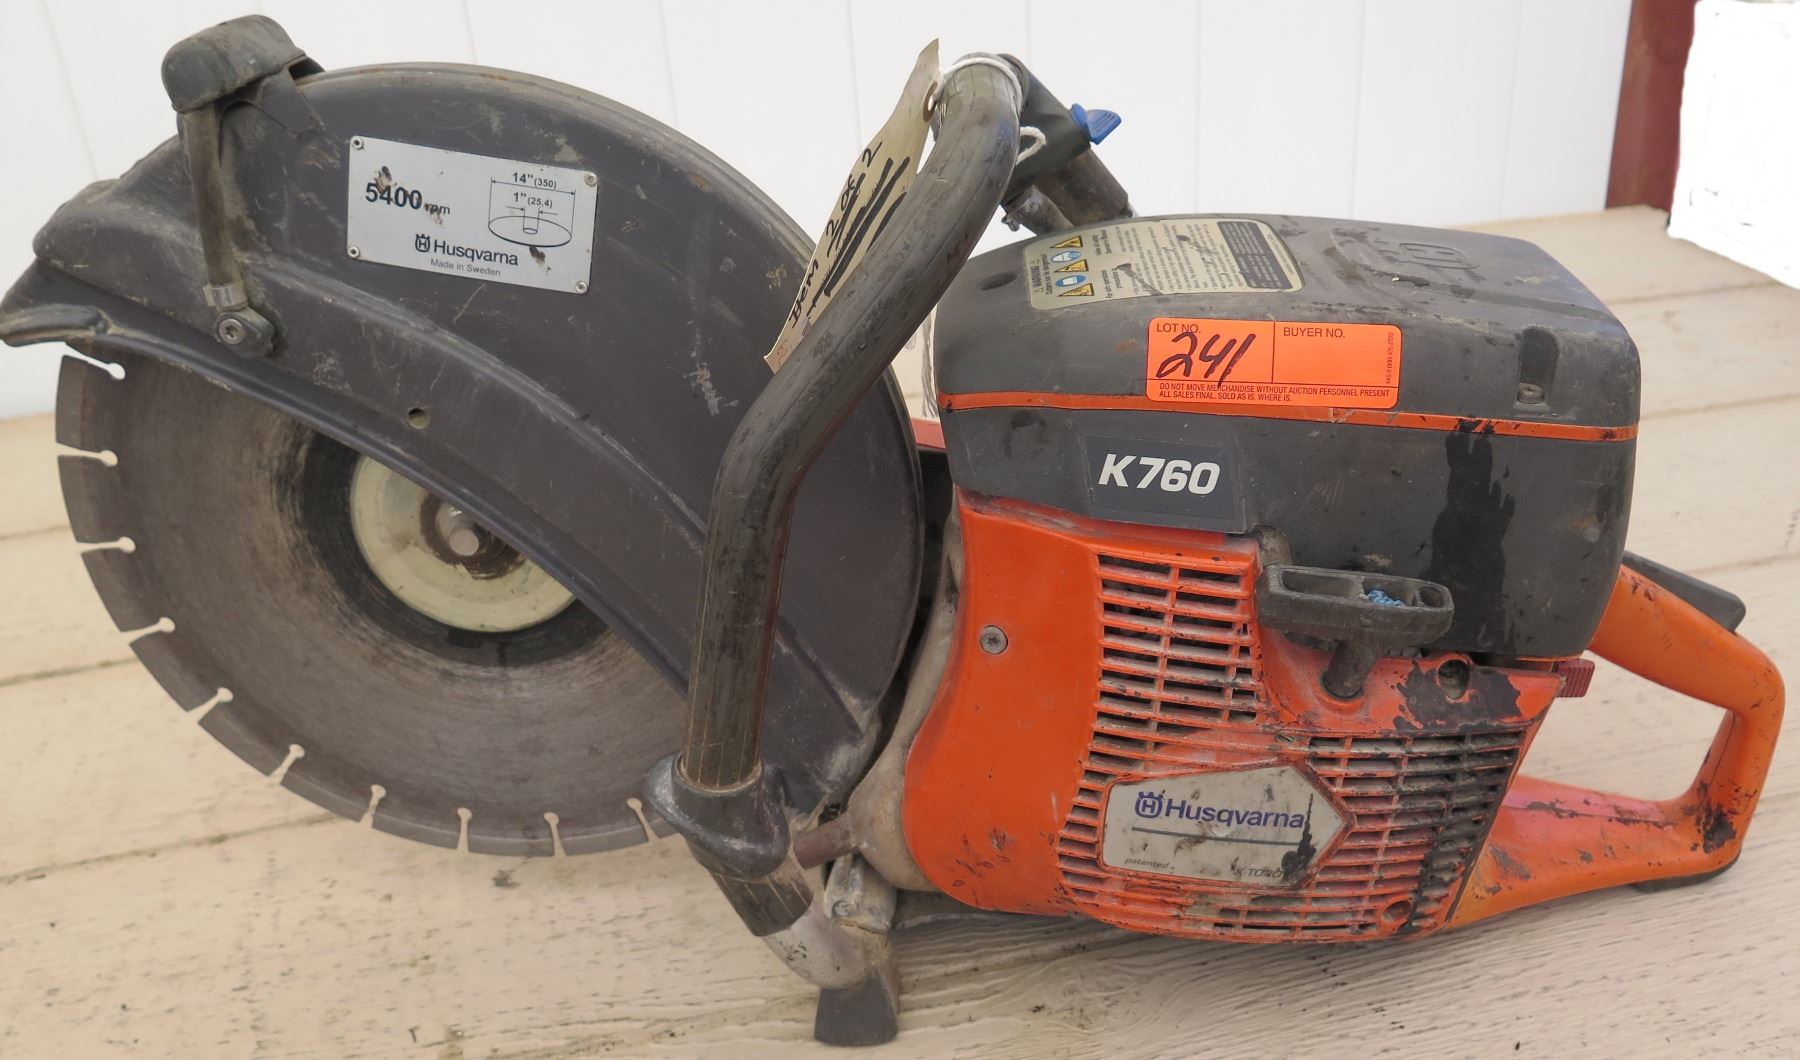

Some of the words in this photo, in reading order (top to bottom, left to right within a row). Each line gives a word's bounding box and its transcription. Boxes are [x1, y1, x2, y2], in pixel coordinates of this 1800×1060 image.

[365, 182, 423, 211] 5400
[433, 239, 519, 266] Husqvarna
[430, 258, 455, 270] Made
[456, 261, 465, 272] in
[466, 263, 501, 277] Sweden
[1156, 322, 1180, 333] LOT
[1181, 323, 1201, 334] NO.
[1283, 326, 1323, 338] BUYER
[1325, 327, 1346, 339] NO.
[1155, 333, 1257, 389] 241
[1159, 390, 1171, 399] ALL
[1172, 391, 1194, 399] SALES
[1217, 392, 1236, 400] SOLD
[1237, 393, 1247, 401] AS
[1258, 394, 1282, 402] WHERE
[1160, 382, 1170, 390] DO
[1171, 382, 1187, 391] NOT
[1189, 383, 1206, 392] MOVE
[1256, 385, 1288, 395] WITHOUT
[1288, 387, 1318, 396] AUCTION
[1319, 388, 1358, 397] PERSONNEL
[1359, 389, 1390, 398] PRESENT
[1164, 798, 1305, 829] Husqvarna
[1123, 856, 1170, 870] patented
